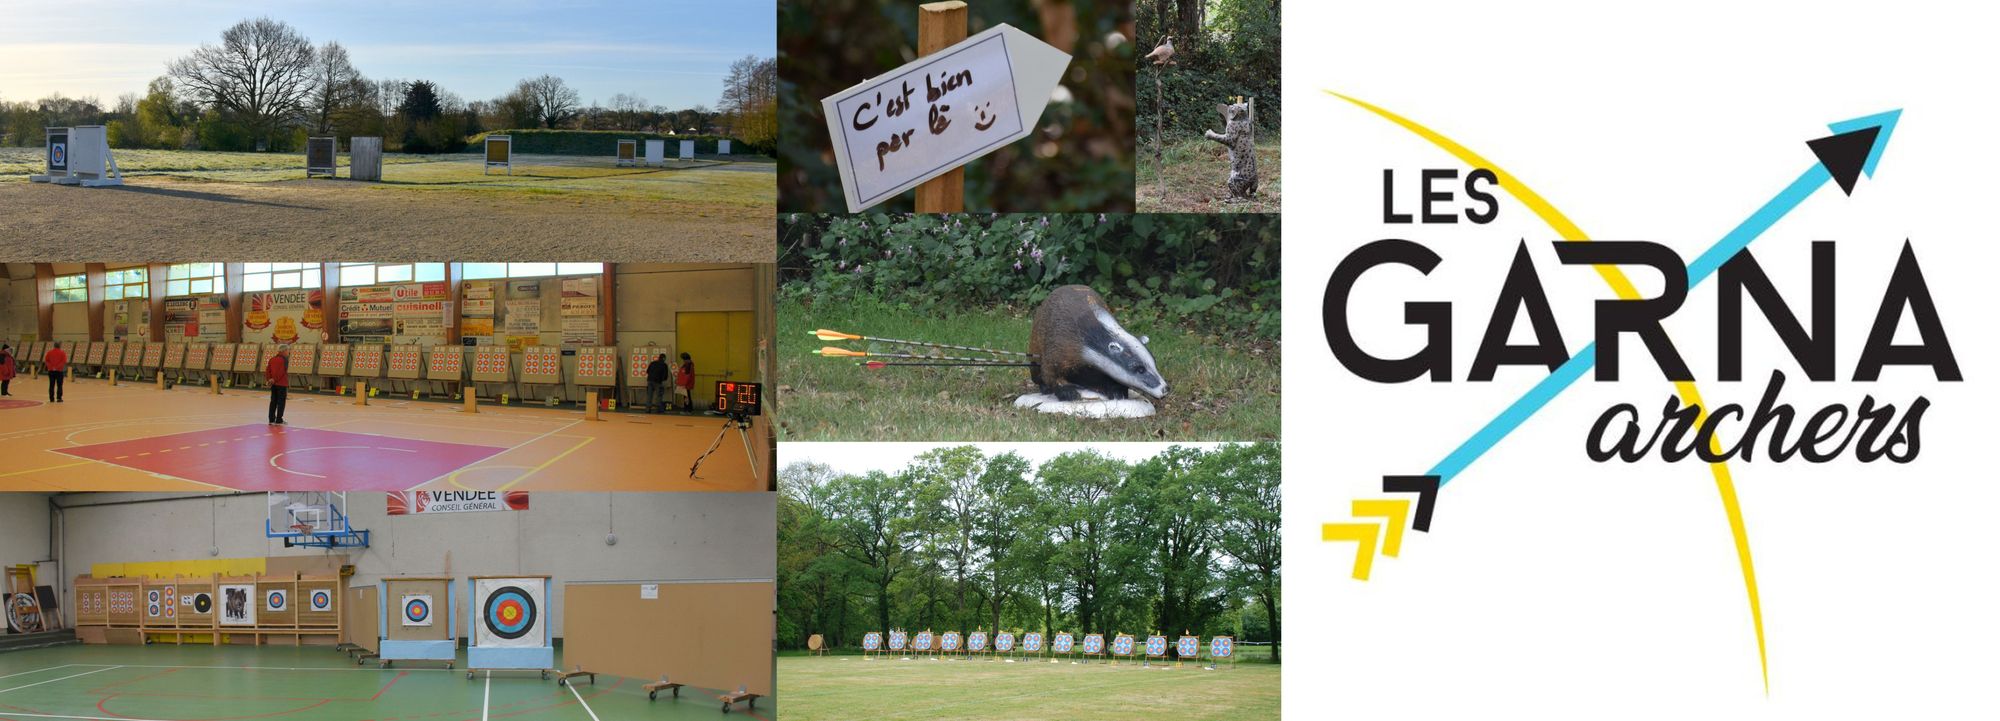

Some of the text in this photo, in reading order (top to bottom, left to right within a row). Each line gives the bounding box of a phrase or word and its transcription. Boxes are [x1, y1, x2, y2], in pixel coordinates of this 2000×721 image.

[853, 69, 973, 131] C'est bien
[876, 103, 951, 171] par là
[369, 303, 393, 311] Mutuel
[432, 503, 460, 511] CONSEIL
